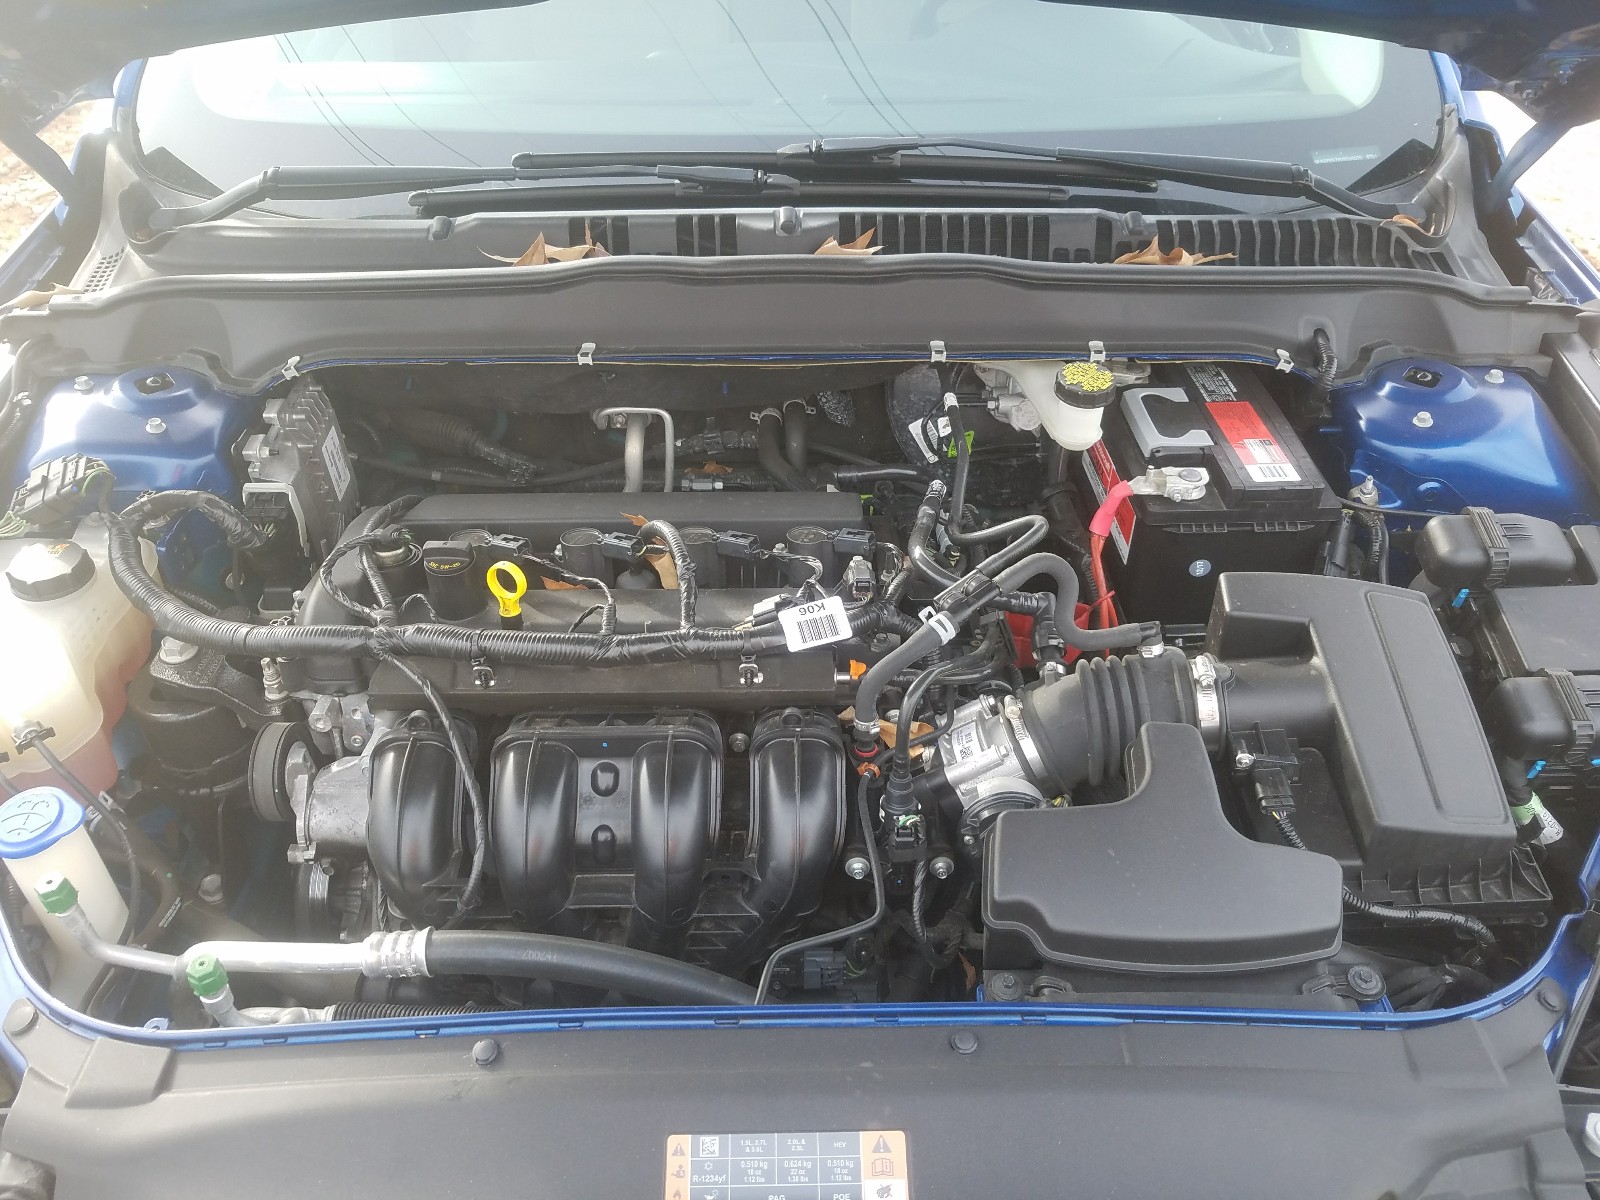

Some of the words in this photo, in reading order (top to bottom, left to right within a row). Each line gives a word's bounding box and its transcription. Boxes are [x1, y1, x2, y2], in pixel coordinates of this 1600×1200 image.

[798, 602, 826, 616] K06
[741, 1160, 758, 1168] 0.510
[760, 1160, 768, 1170] kg
[784, 1160, 802, 1168] 0.624
[803, 1160, 812, 1169] kg
[827, 1159, 844, 1167] 0.510
[846, 1159, 854, 1168] kg
[693, 1174, 727, 1184] R-1234yf
